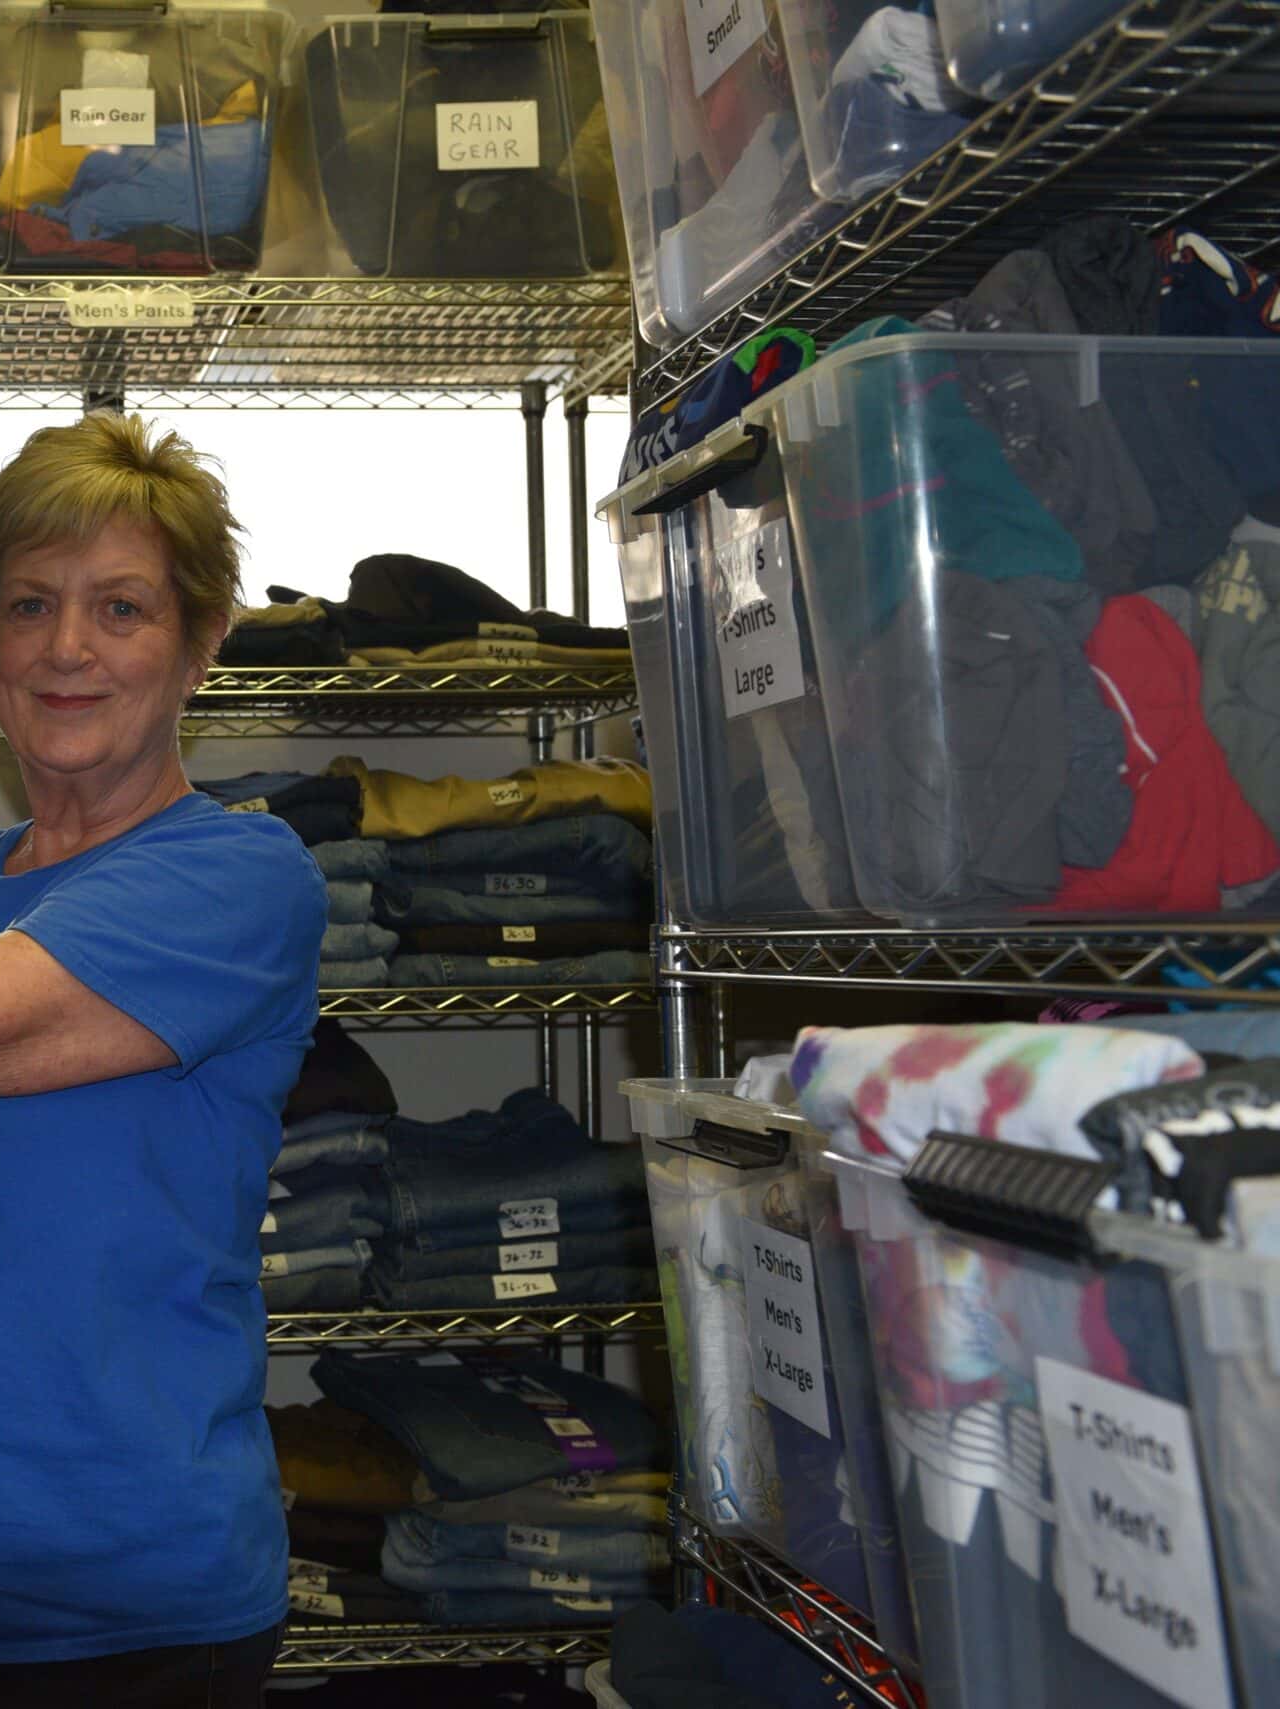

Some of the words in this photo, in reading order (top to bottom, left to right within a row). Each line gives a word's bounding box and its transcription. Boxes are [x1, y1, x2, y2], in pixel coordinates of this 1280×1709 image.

[706, 0, 742, 55] Small
[70, 109, 107, 122] Rain
[108, 108, 147, 123] Gear
[449, 111, 514, 135] RAIN
[448, 139, 522, 163] GEAR
[74, 302, 130, 319] Men's
[133, 303, 187, 319] Pants
[733, 662, 776, 696] Large
[753, 1244, 804, 1284] T-Shirts
[763, 1296, 804, 1335] Men's
[763, 1345, 815, 1394] X-Large
[1068, 1400, 1178, 1477] T-Shirts
[1089, 1486, 1175, 1558] Men's
[1088, 1562, 1200, 1653] X-Large
